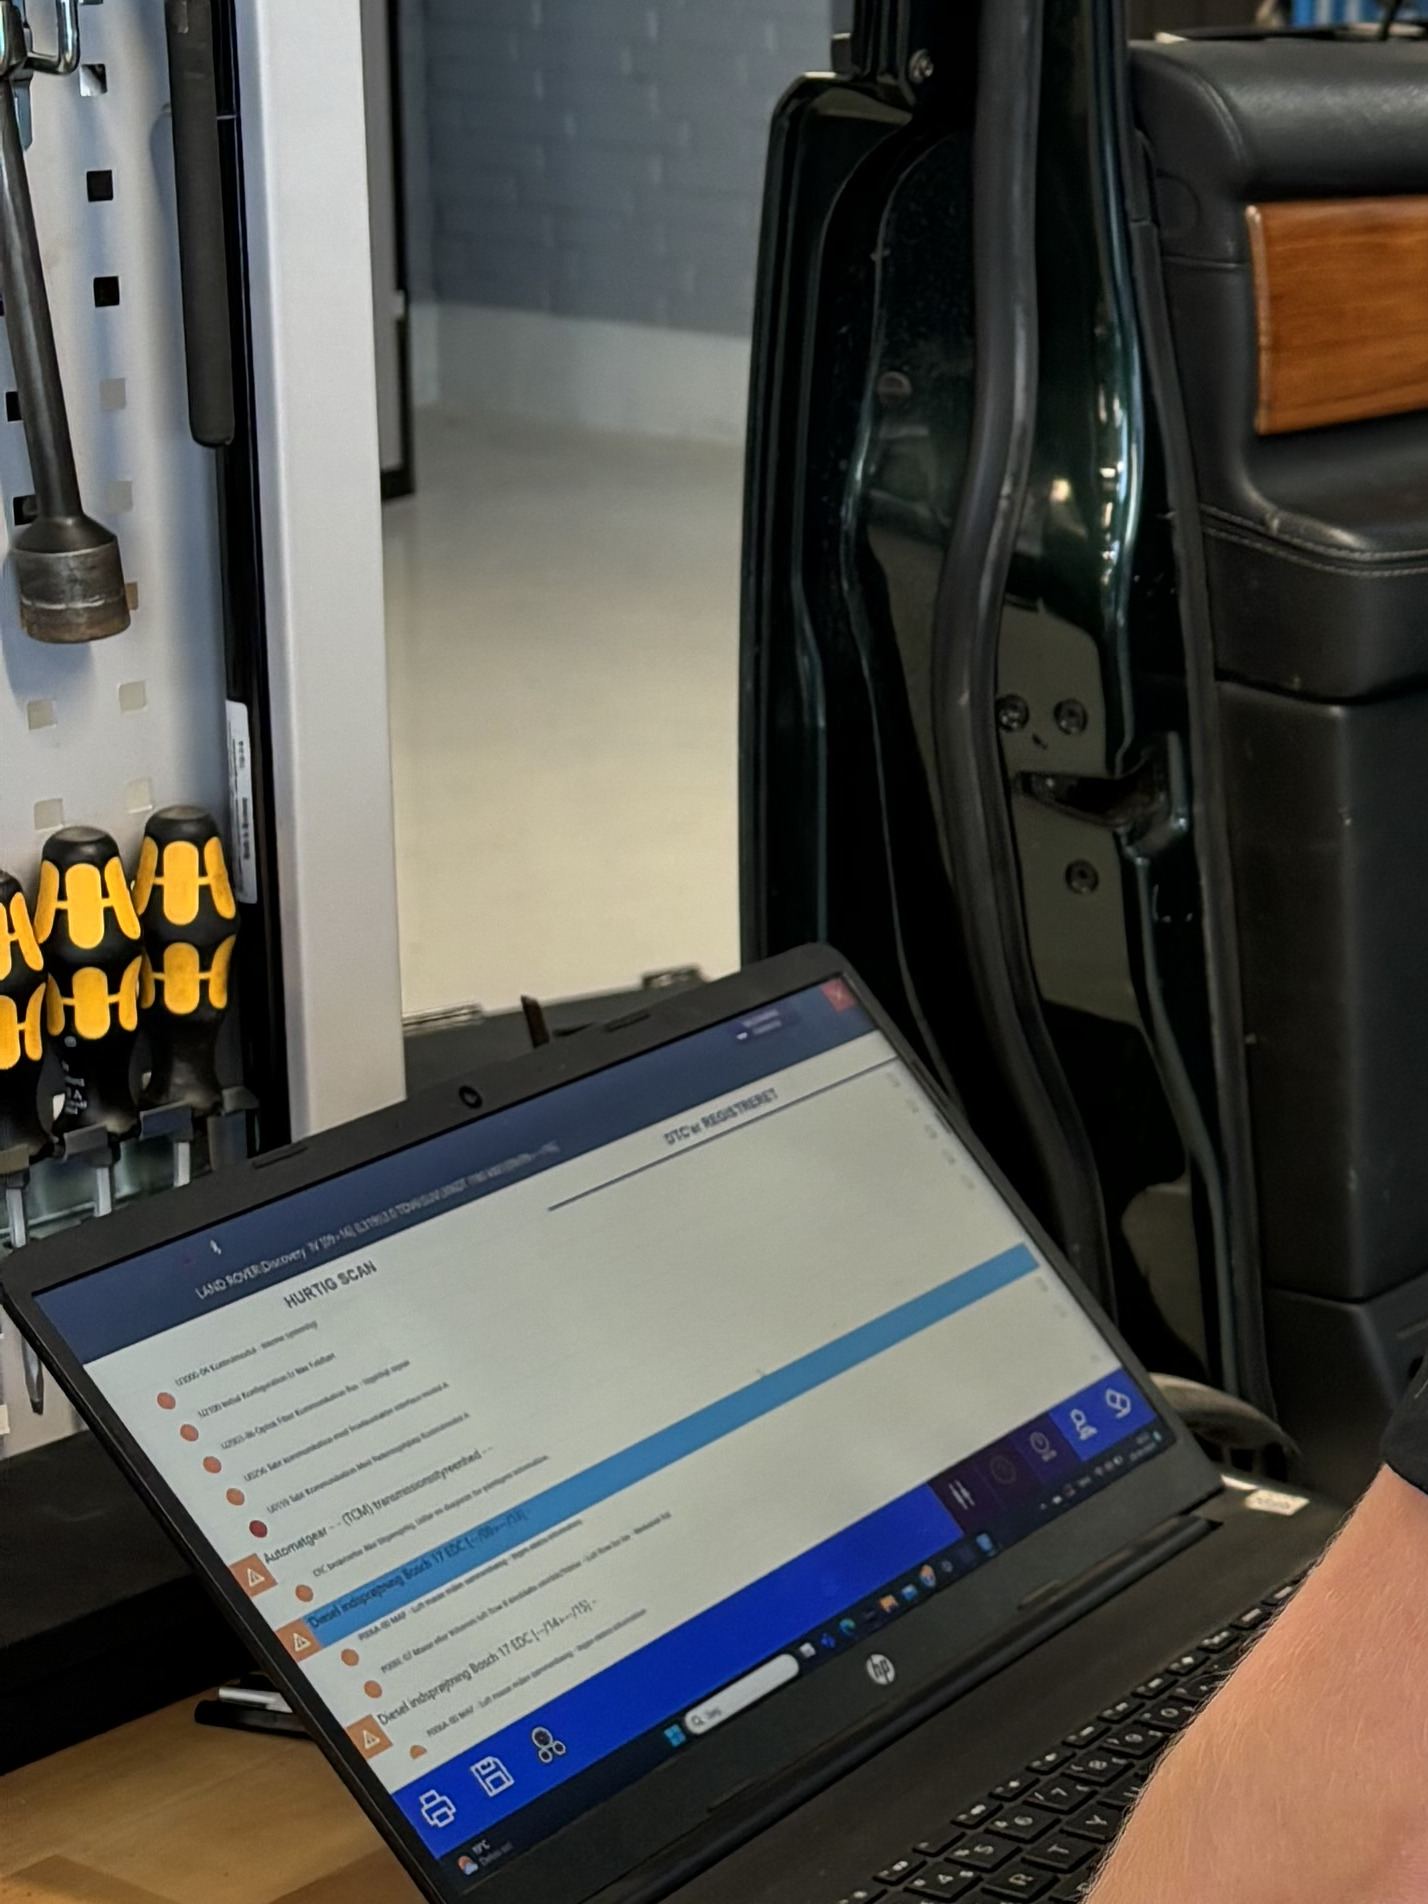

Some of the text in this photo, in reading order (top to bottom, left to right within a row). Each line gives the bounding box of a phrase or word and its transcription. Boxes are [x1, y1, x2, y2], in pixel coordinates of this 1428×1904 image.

[194, 1278, 230, 1300] LAND
[282, 1260, 378, 1308] HURTIG SCAN
[262, 1525, 331, 1566] Automatgear
[867, 1654, 894, 1684] hp
[375, 1699, 411, 1727] Diesel
[467, 1649, 501, 1676] Bosch
[1085, 1814, 1108, 1826] Y
[1047, 1845, 1069, 1855] T
[1009, 1873, 1034, 1886] R
